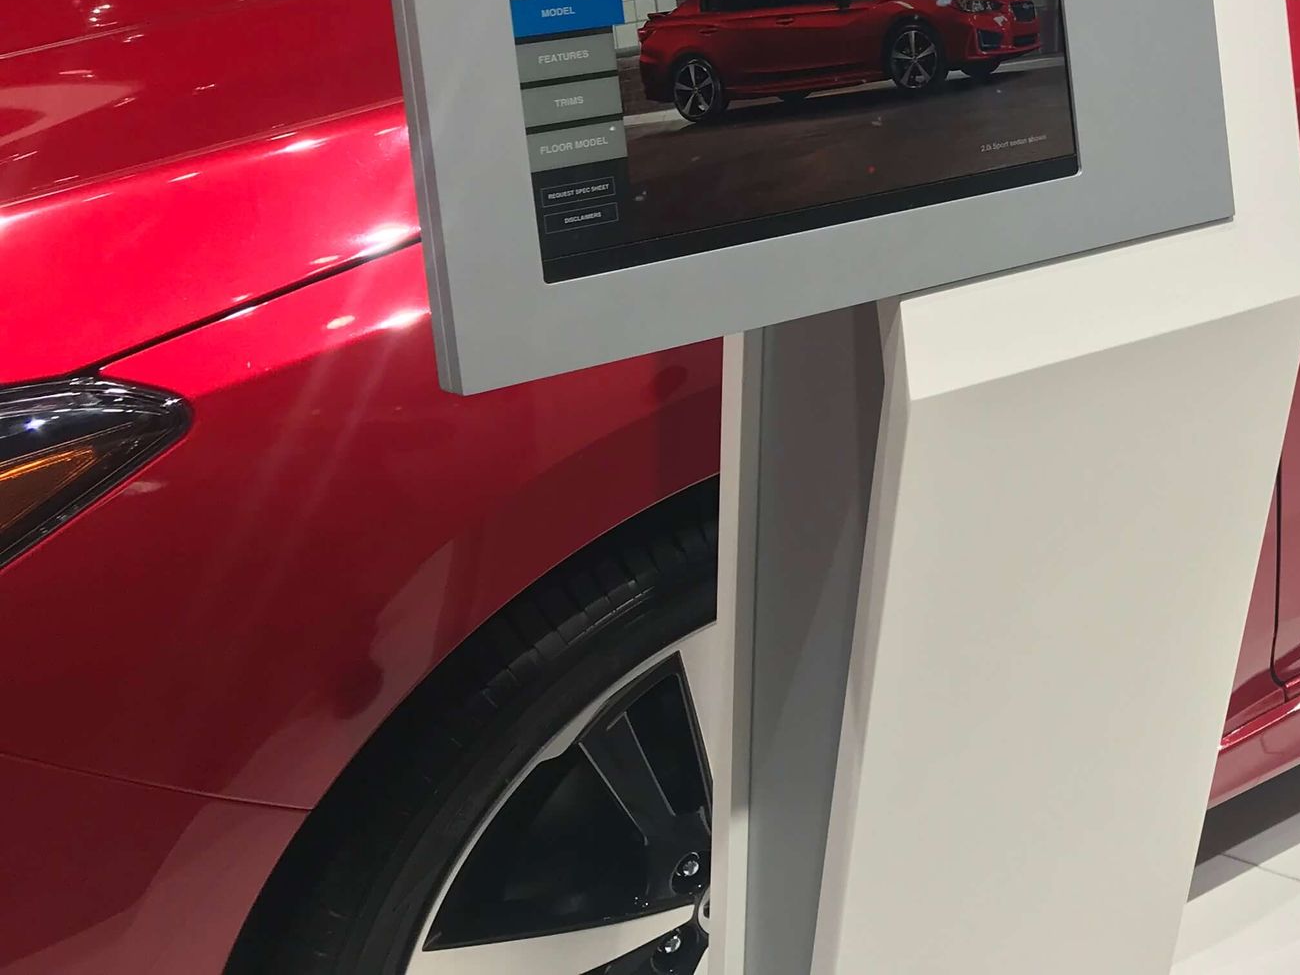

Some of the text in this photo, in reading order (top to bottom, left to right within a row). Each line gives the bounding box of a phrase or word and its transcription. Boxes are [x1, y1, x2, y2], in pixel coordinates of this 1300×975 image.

[541, 6, 576, 18] MODEL
[538, 49, 589, 65] FEATURES
[554, 95, 584, 108] TRIMS
[540, 136, 608, 155] FLOOR MODEL
[548, 183, 609, 199] REQUEST SPEC SHEET
[564, 212, 601, 224] DISCLAIMERS
